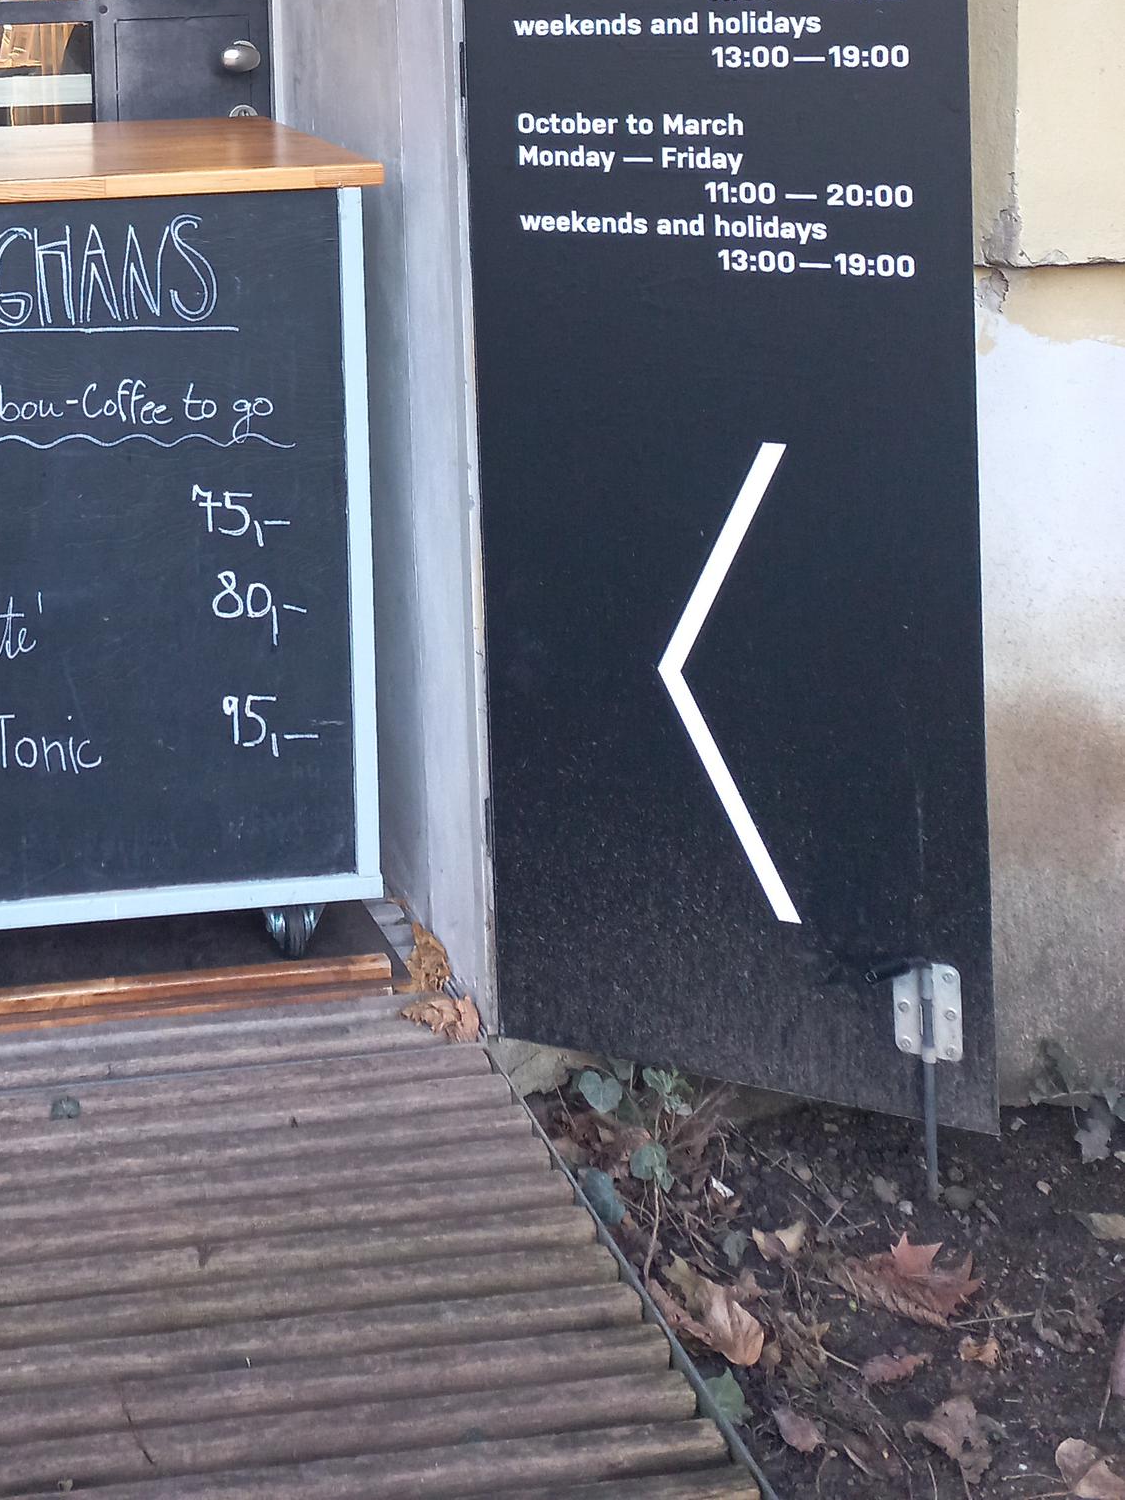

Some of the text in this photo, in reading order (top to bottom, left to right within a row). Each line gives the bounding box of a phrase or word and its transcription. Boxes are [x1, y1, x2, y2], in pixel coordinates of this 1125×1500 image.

[513, 10, 822, 39] weekends and holidays
[517, 112, 744, 136] October to March
[518, 144, 616, 173] Monday
[661, 146, 744, 176] Friday
[519, 210, 828, 245] weekends and holidays
[183, 382, 219, 423] to
[231, 395, 275, 444] go
